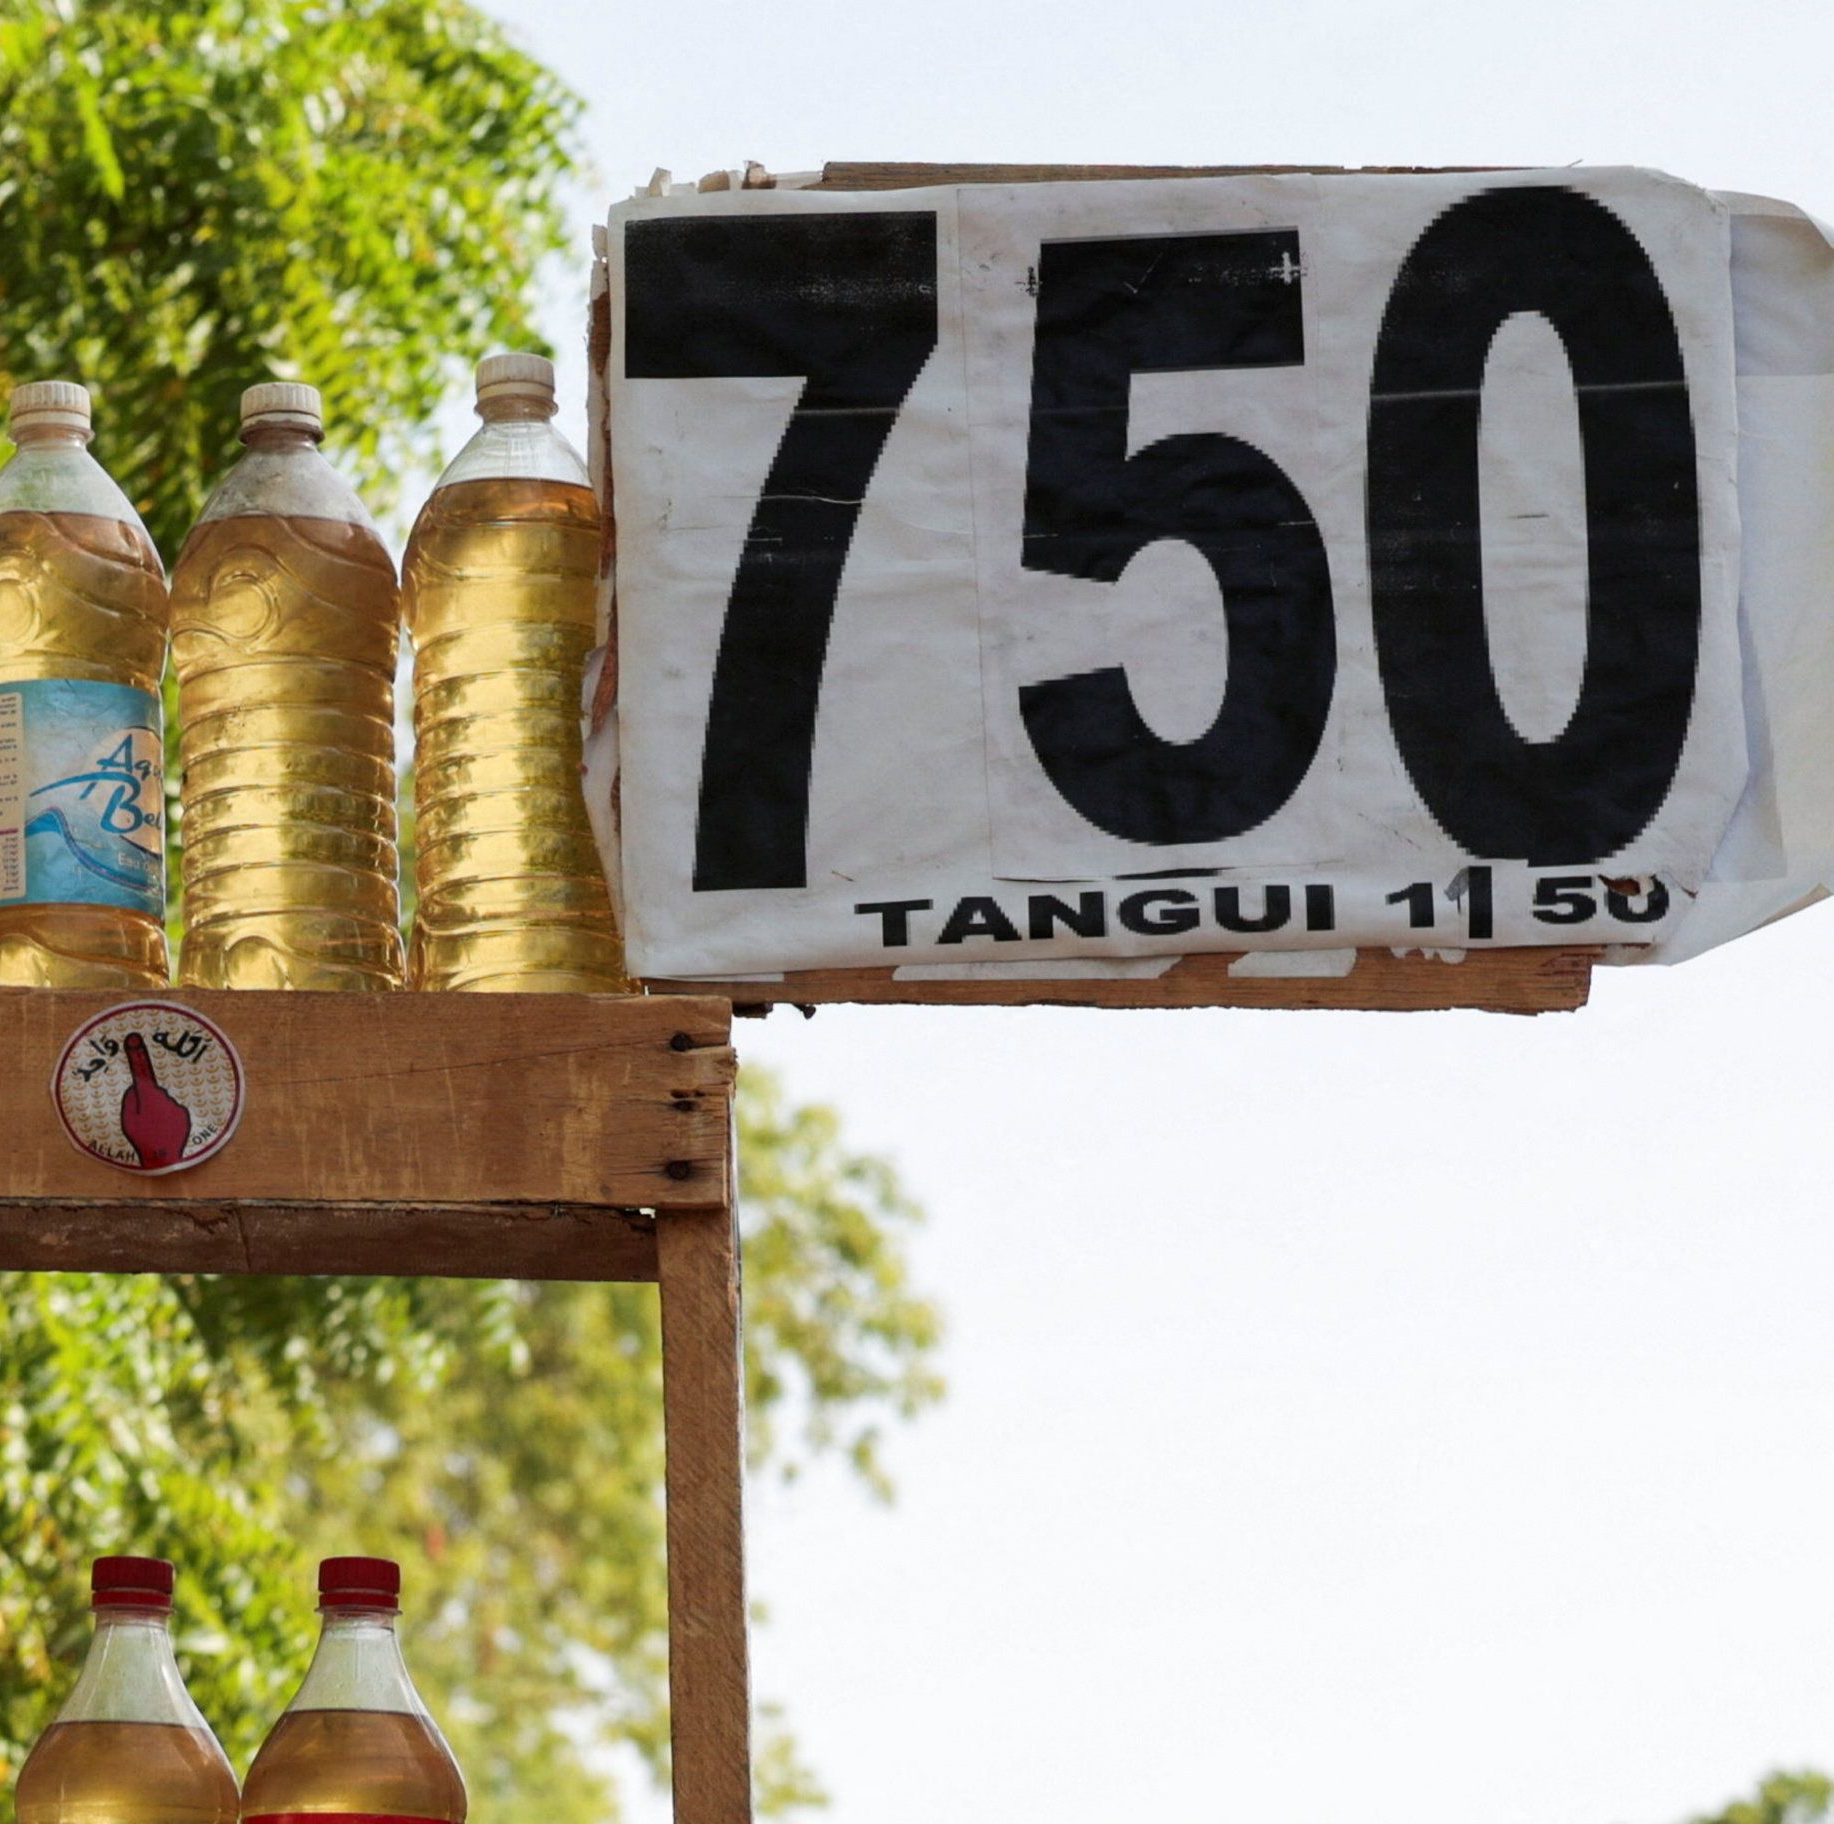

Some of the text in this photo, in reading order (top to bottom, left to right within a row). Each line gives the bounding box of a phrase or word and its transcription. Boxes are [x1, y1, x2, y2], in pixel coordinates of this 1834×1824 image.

[624, 183, 1703, 890] 750
[853, 883, 1335, 947] TANGUI
[88, 1140, 136, 1162] ALLAH
[191, 1124, 217, 1146] ONE
